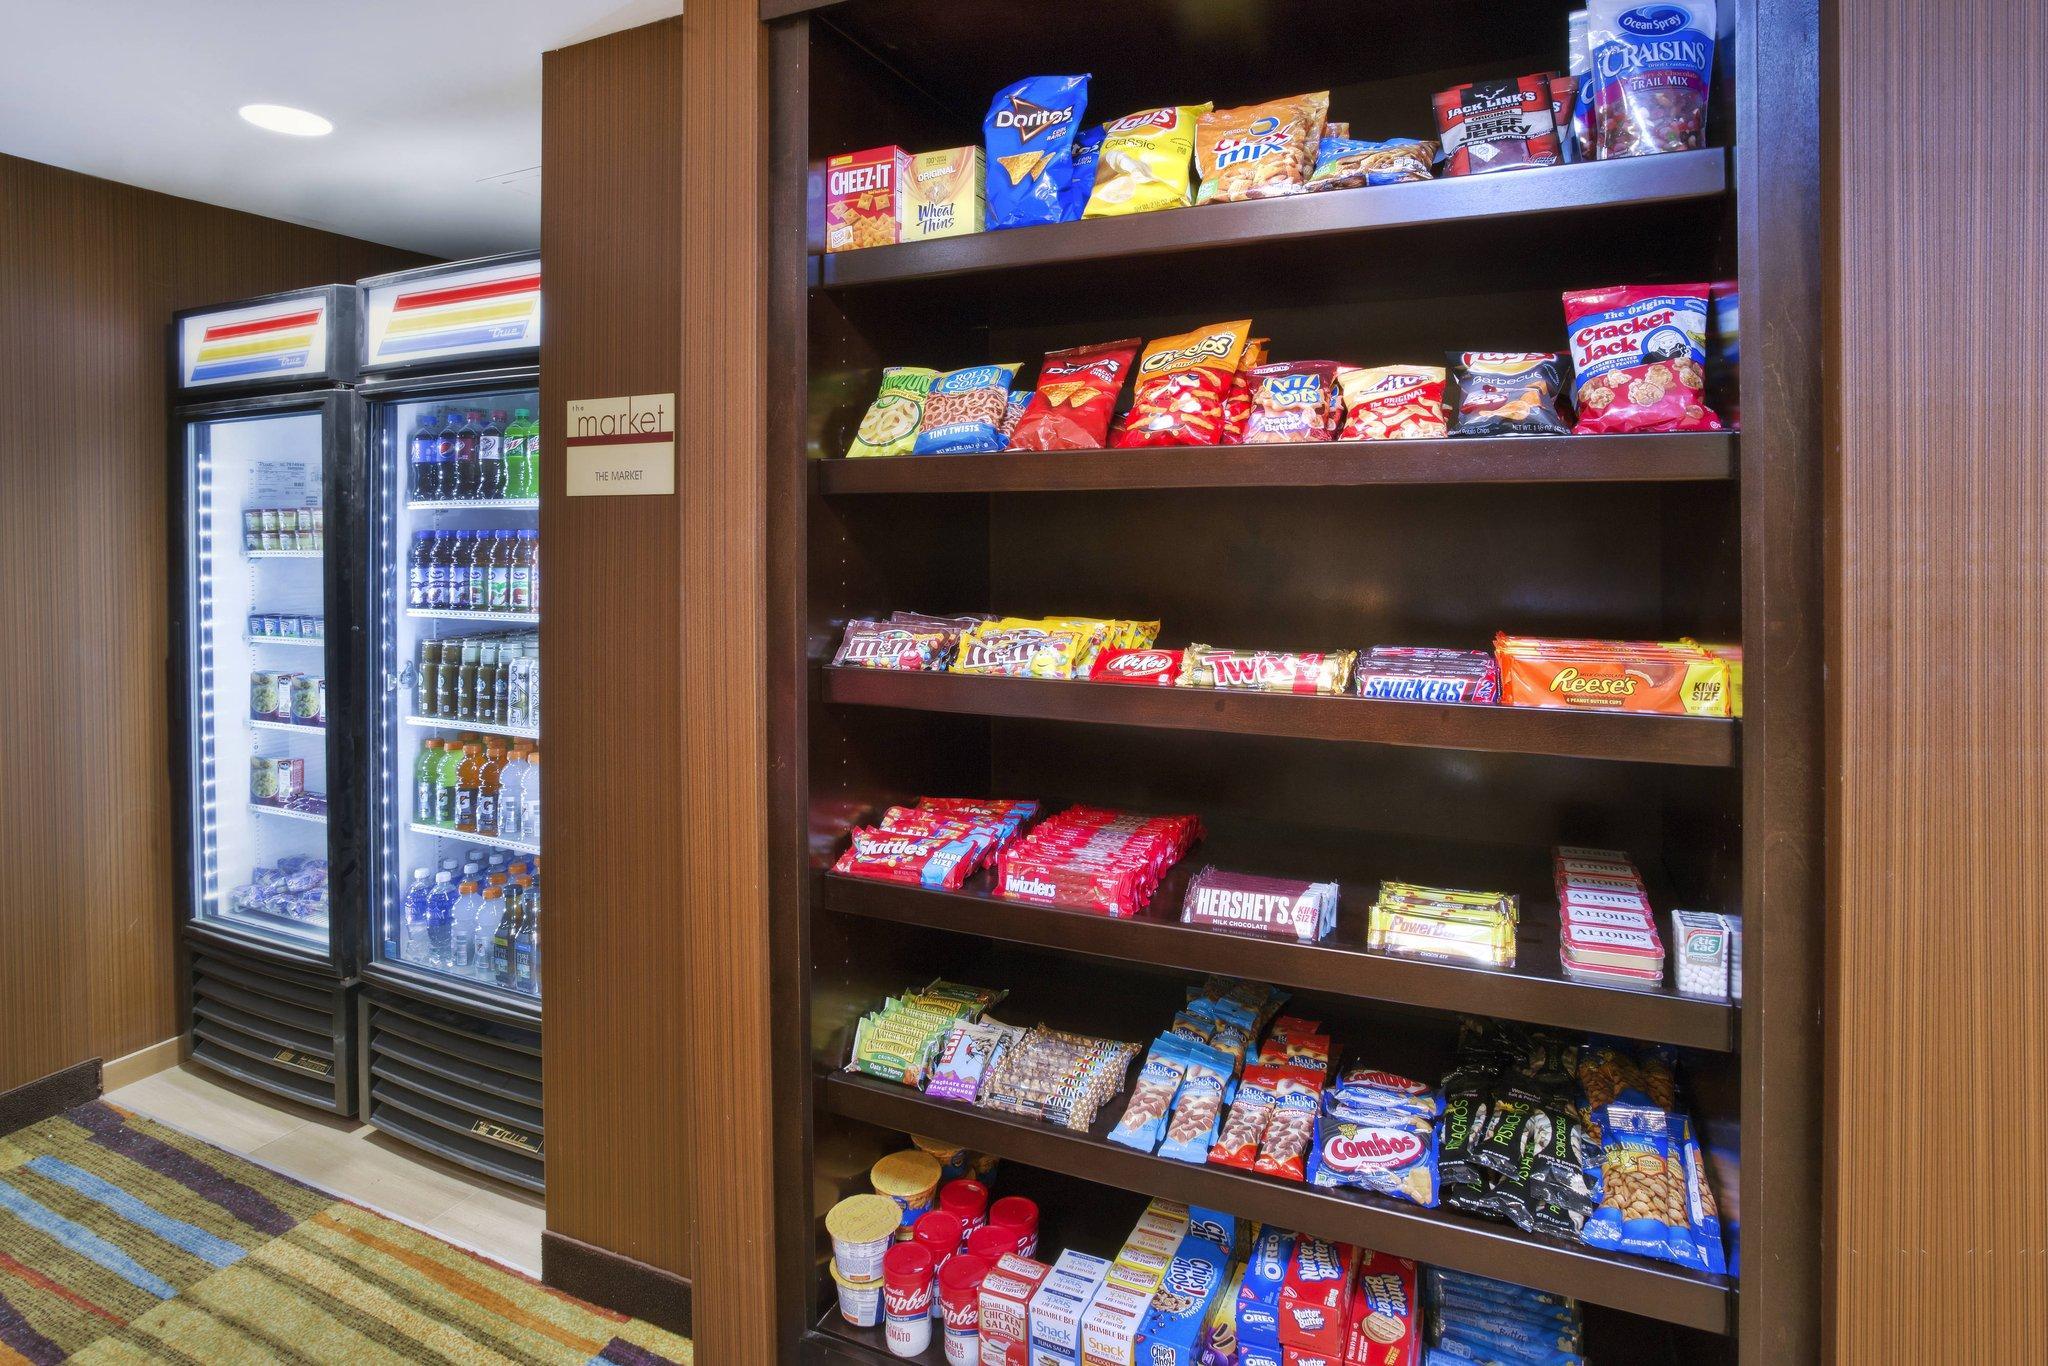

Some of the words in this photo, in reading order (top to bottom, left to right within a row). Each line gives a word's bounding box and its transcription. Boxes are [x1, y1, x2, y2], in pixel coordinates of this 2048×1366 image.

[1624, 16, 1653, 30] Ocean
[1654, 14, 1681, 31] Spray
[1598, 40, 1706, 78] CRAISINS
[1632, 79, 1664, 90] TRAIL
[1667, 76, 1688, 87] MIX
[1448, 101, 1483, 119] JACK
[1486, 91, 1537, 108] LINK'S
[996, 106, 1073, 128] Doritos
[1471, 110, 1516, 122] ORIGINAL
[1465, 118, 1523, 132] BEEF
[1460, 125, 1533, 141] JERKY
[1104, 138, 1156, 151] Classic
[830, 163, 891, 196] CHEEZ-IT
[917, 165, 956, 182] ORIGINAL
[918, 201, 955, 222] Wheat
[915, 217, 955, 235] Thins
[1604, 311, 1625, 319] The
[1628, 299, 1675, 315] Original
[488, 325, 520, 338] True
[1576, 311, 1674, 348] Cracker
[1578, 337, 1639, 367] Jack
[945, 374, 990, 389] GOLD
[956, 368, 992, 382] ROLD
[1276, 389, 1318, 405] bits
[1384, 389, 1426, 404] ORIGINAL
[577, 396, 664, 437] market
[928, 428, 949, 439] TINY
[950, 424, 980, 434] TWISTS
[595, 471, 609, 481] THE
[611, 470, 643, 481] MARKET
[1550, 667, 1637, 695] Reese's
[1693, 682, 1720, 692] KING
[1364, 680, 1465, 701] SNICKERS
[1691, 691, 1719, 702] SIZE
[857, 840, 929, 858] Skittles
[933, 850, 962, 863] SHARE
[934, 858, 951, 868] SIZE
[1006, 875, 1056, 898] Twizzlers
[1196, 887, 1290, 925] HERSHEY'S
[1573, 893, 1637, 904] ALTOIDS
[1296, 915, 1316, 923] SIZE
[1298, 906, 1318, 917] KING
[1574, 910, 1641, 923] ALTOIDS
[1229, 920, 1268, 931] CHOCOLATE
[1576, 928, 1647, 942] ALTOIDS
[1696, 935, 1717, 946] tic
[1693, 942, 1715, 953] tac
[877, 1054, 900, 1063] CRUNCHY
[1294, 1056, 1314, 1064] BLUE
[869, 1062, 883, 1072] Oats
[888, 1067, 904, 1077] Honey
[1147, 1064, 1168, 1073] BLUE
[1243, 1088, 1260, 1097] BLUE
[1285, 1095, 1307, 1105] BLUE
[1045, 1095, 1074, 1109] KIND
[1331, 1133, 1415, 1160] Combos
[1264, 1235, 1283, 1280] OREO
[1299, 1242, 1321, 1281] Nutter
[1315, 1240, 1339, 1280] Butter
[1189, 1259, 1213, 1289] Chips
[1364, 1275, 1392, 1317] Butter
[1380, 1274, 1406, 1316] Nutter
[981, 1300, 1004, 1310] BUMBLE
[1005, 1305, 1016, 1314] BEE
[1180, 1298, 1205, 1318] ORIGINAL
[1293, 1308, 1321, 1320] Nutter
[984, 1310, 1021, 1328] CHICKEN
[1036, 1307, 1062, 1320] BUMBLE
[1063, 1316, 1075, 1325] BEE
[1243, 1313, 1275, 1323] OREO
[1299, 1316, 1324, 1329] Butter
[986, 1320, 1020, 1337] SALAD
[1036, 1320, 1071, 1341] Snack
[1089, 1323, 1116, 1338] BUMBLE
[1117, 1332, 1129, 1341] BEE
[1037, 1340, 1053, 1348] TUNA
[1053, 1344, 1071, 1355] SALAD
[1088, 1337, 1125, 1358] Snack
[1152, 1344, 1171, 1358] Chips
